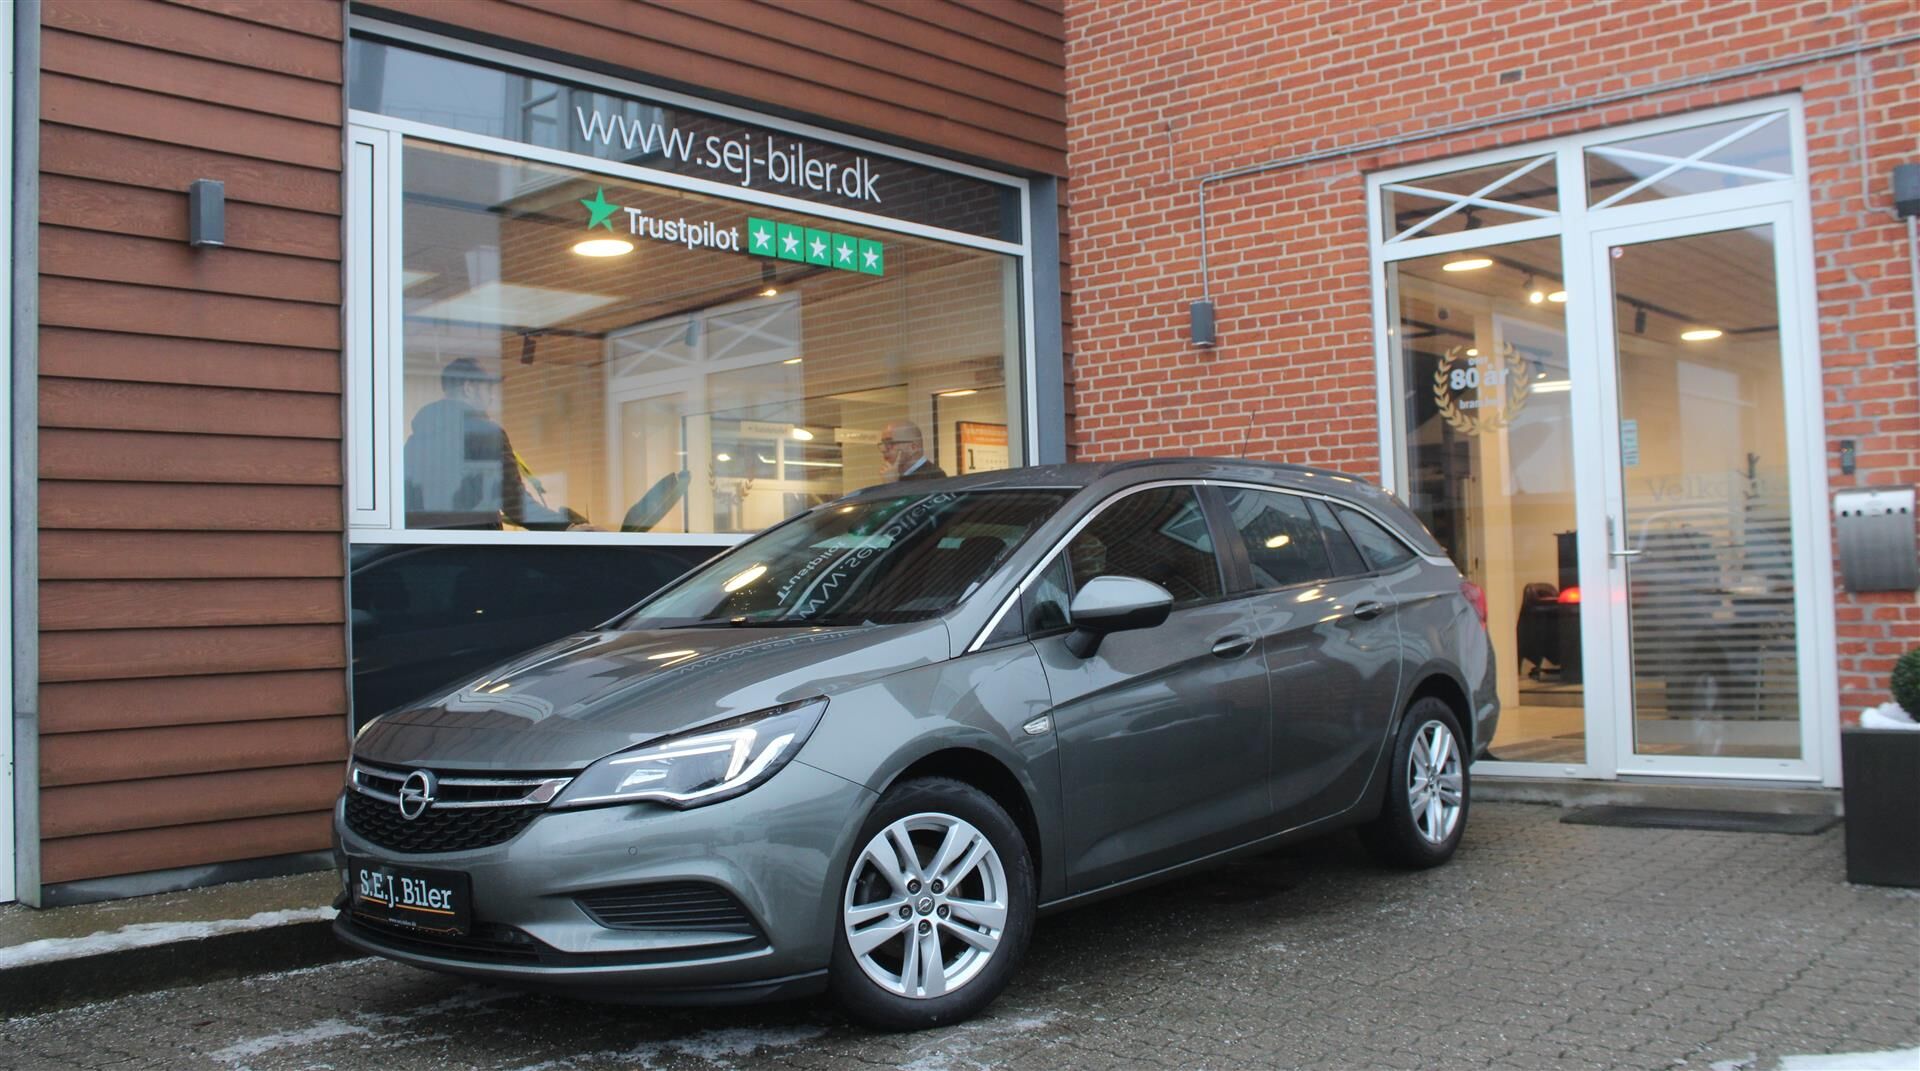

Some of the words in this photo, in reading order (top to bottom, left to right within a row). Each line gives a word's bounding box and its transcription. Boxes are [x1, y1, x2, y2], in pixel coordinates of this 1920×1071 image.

[576, 105, 882, 203] www.sej-biler.dk
[624, 206, 739, 251] Trustpilot
[1450, 367, 1480, 390] 80
[360, 869, 399, 908] S.E.J.
[401, 877, 452, 909] Biler
